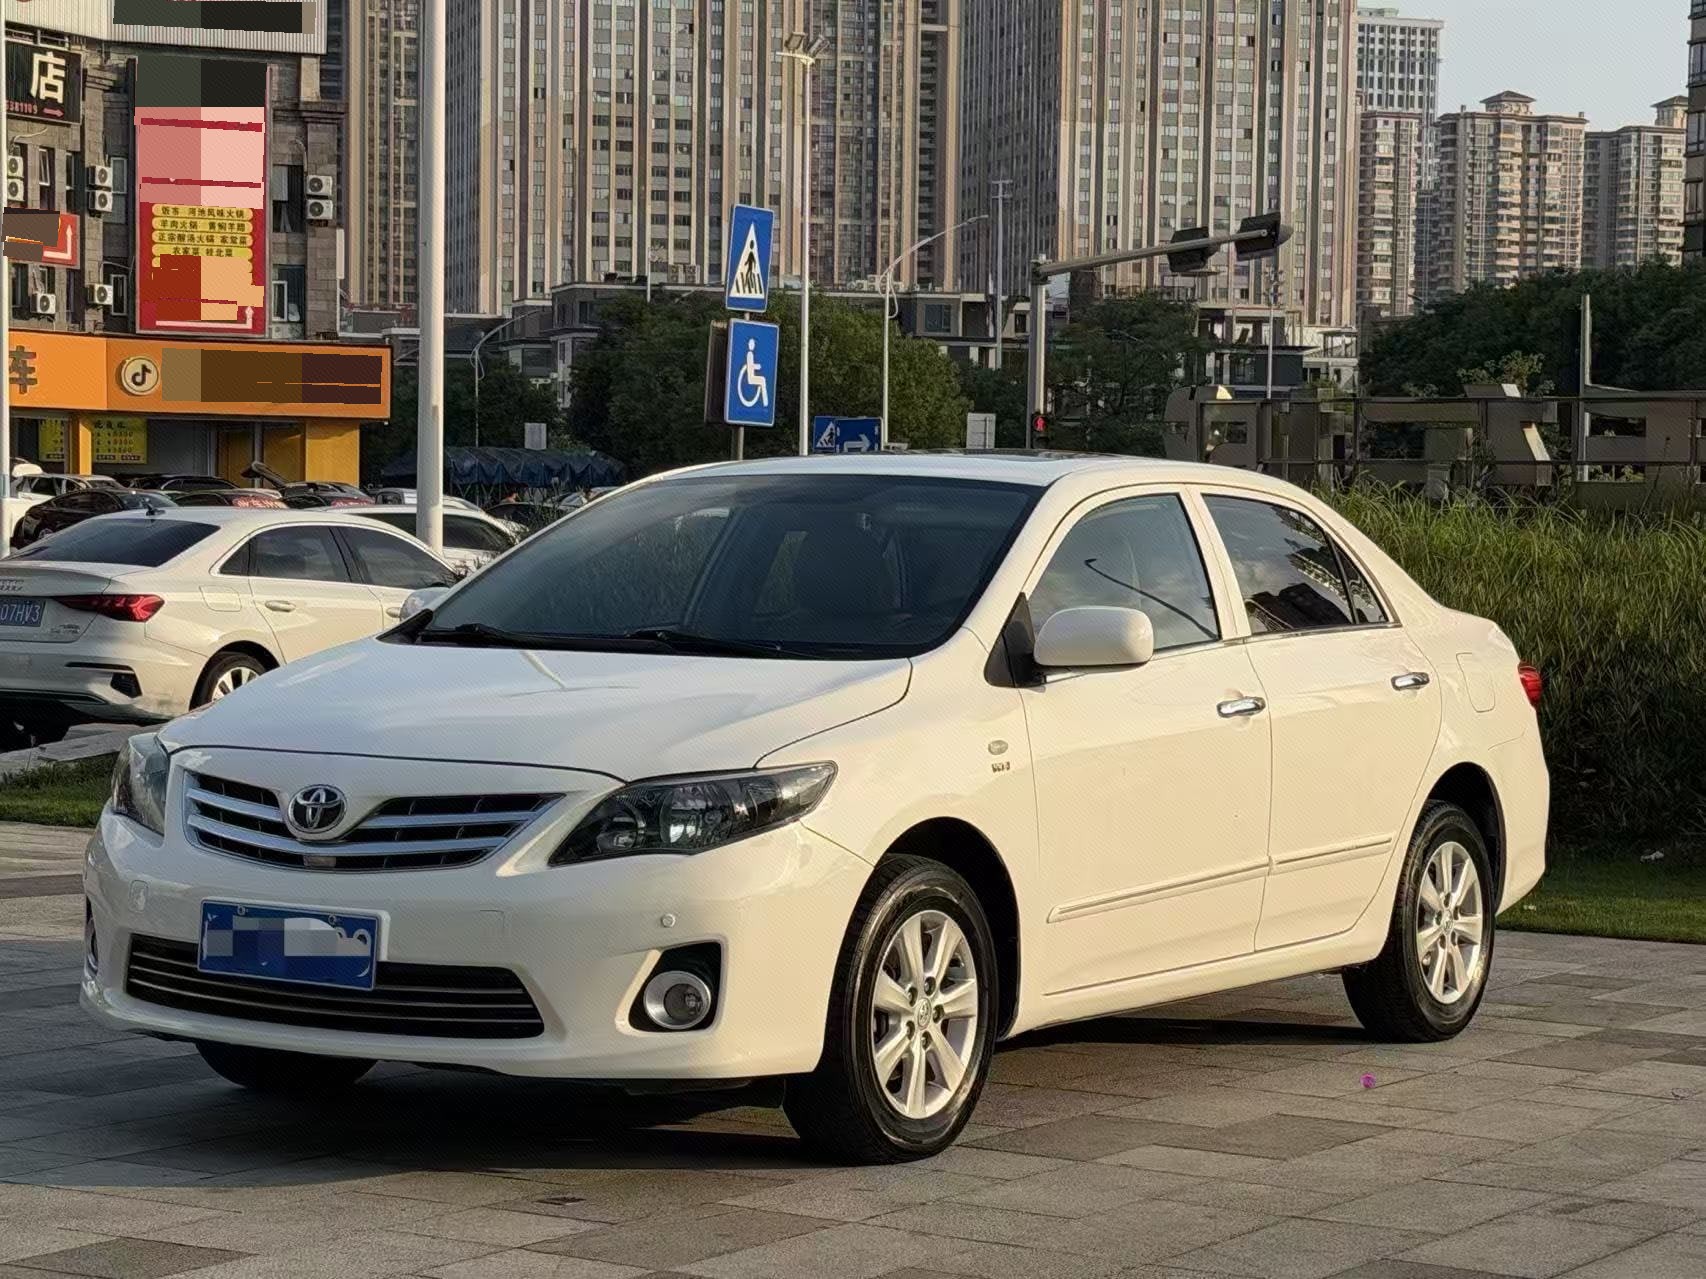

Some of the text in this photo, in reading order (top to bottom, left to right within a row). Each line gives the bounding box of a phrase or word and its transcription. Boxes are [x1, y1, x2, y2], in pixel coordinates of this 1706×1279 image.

[30, 51, 66, 103] 店
[160, 219, 198, 230] 羊肉火锅
